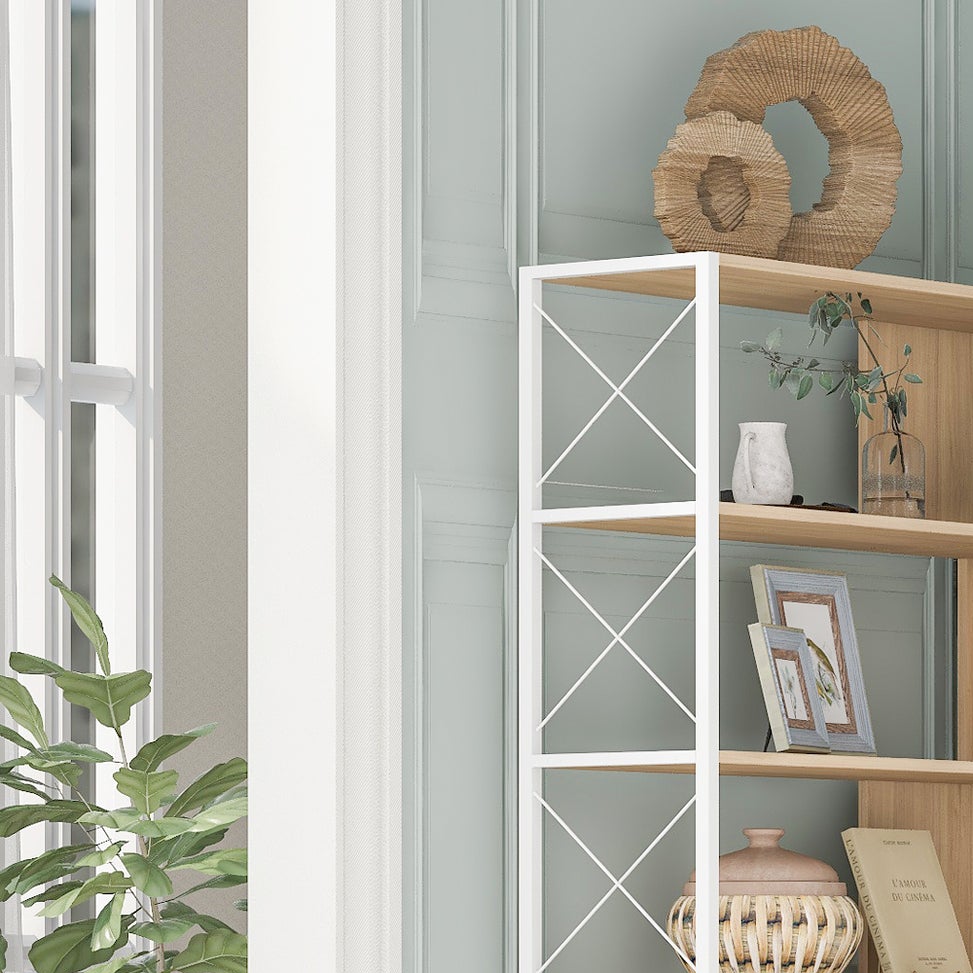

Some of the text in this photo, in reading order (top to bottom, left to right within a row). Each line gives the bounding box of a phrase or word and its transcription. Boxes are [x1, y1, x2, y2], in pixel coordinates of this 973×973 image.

[846, 838, 866, 889] L'AMOUR
[862, 895, 873, 911] DU
[891, 878, 928, 889] L'AMOUR
[891, 892, 904, 902] DU
